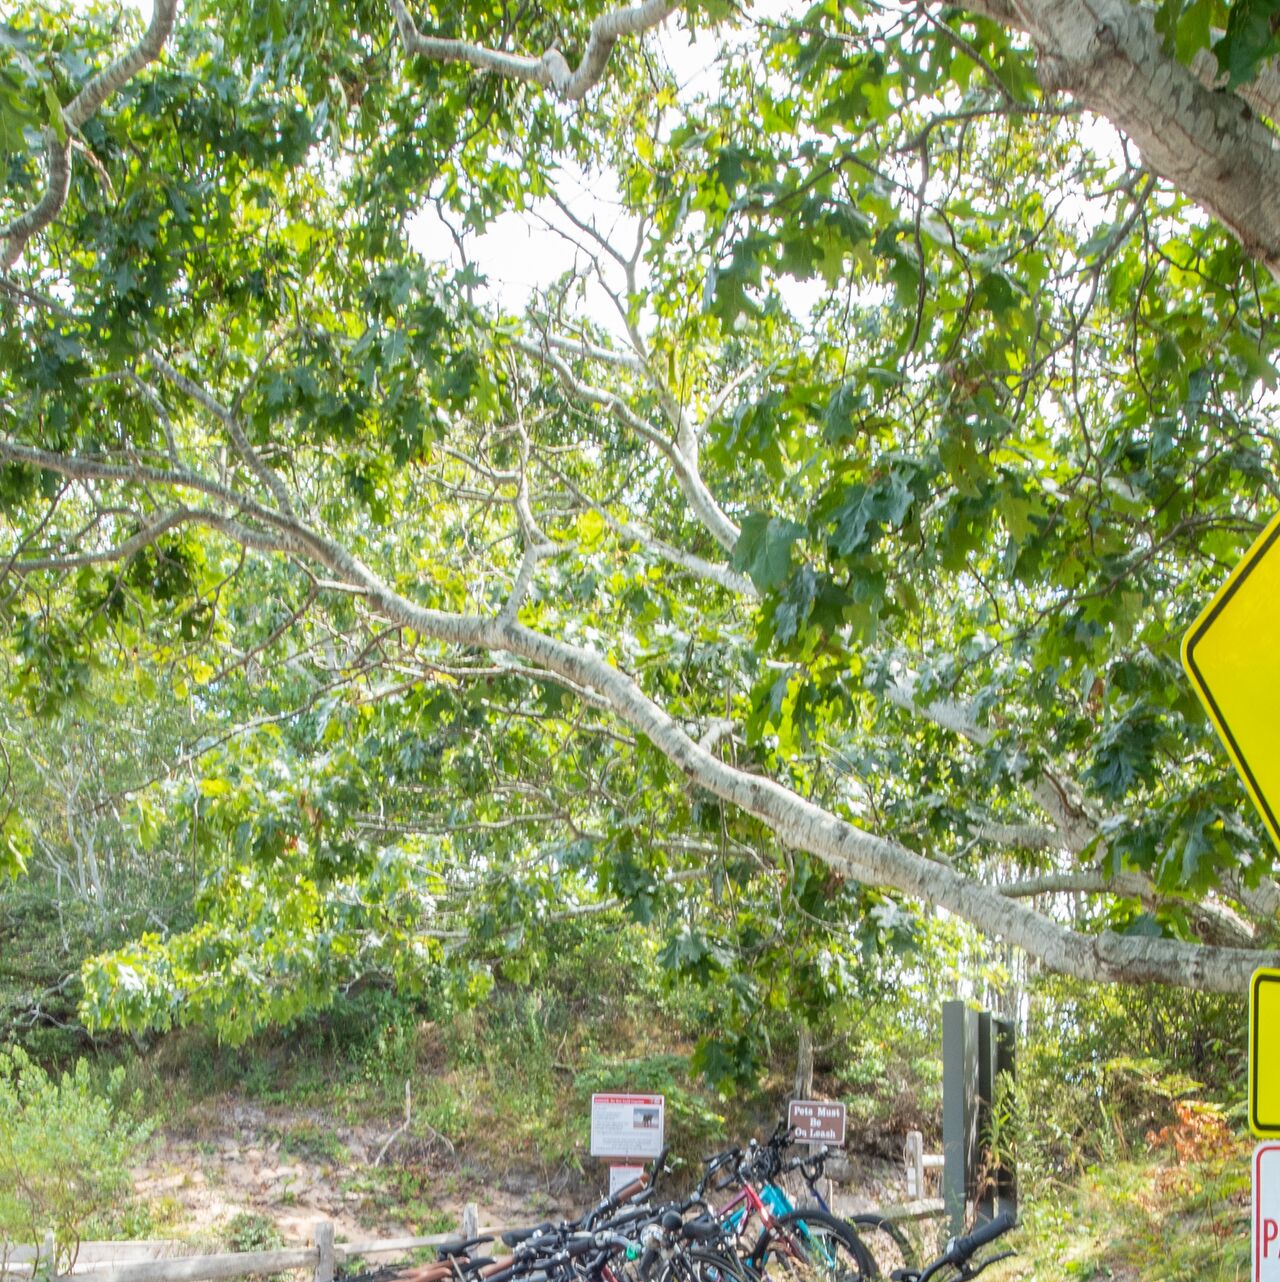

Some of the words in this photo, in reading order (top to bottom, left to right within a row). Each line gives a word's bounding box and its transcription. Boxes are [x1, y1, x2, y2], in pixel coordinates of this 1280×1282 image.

[794, 1105, 813, 1117] Pets
[818, 1106, 840, 1119] Must
[810, 1116, 822, 1128] Be
[795, 1127, 807, 1138] On
[810, 1128, 836, 1139] Leash
